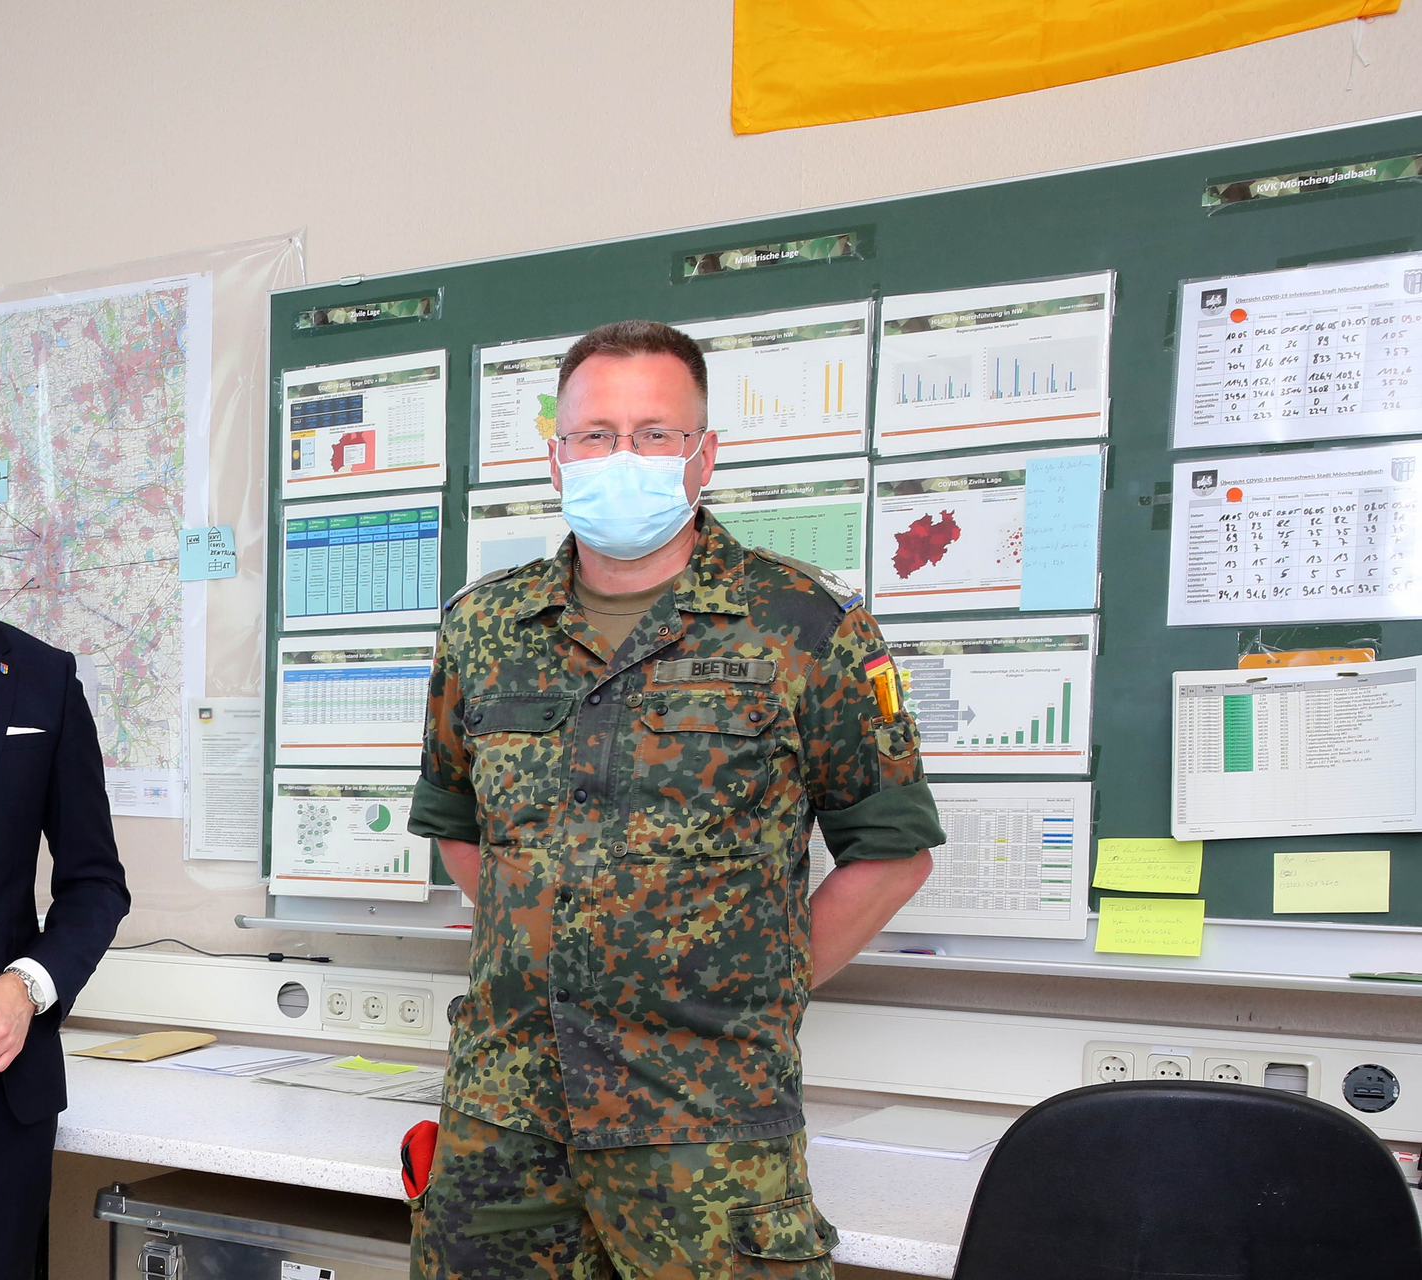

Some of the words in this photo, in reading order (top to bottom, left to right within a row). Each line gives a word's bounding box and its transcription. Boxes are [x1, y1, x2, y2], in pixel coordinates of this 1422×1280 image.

[1257, 184, 1277, 193] KVK
[1280, 167, 1376, 190] Mönchengladbach
[735, 252, 779, 264] Militärische
[781, 250, 798, 259] Lage
[1235, 295, 1261, 304] Übersicht
[1262, 293, 1288, 301] COVID-19
[1338, 282, 1389, 293] Mönchengladbach
[351, 310, 366, 318] Zivile
[367, 309, 380, 317] Lage
[1246, 476, 1272, 484] COVID-19
[1332, 468, 1384, 477] Mönchengladbach
[938, 480, 968, 488] COVID-19
[700, 492, 744, 501] sammenfassung
[692, 660, 748, 676] BEETEN
